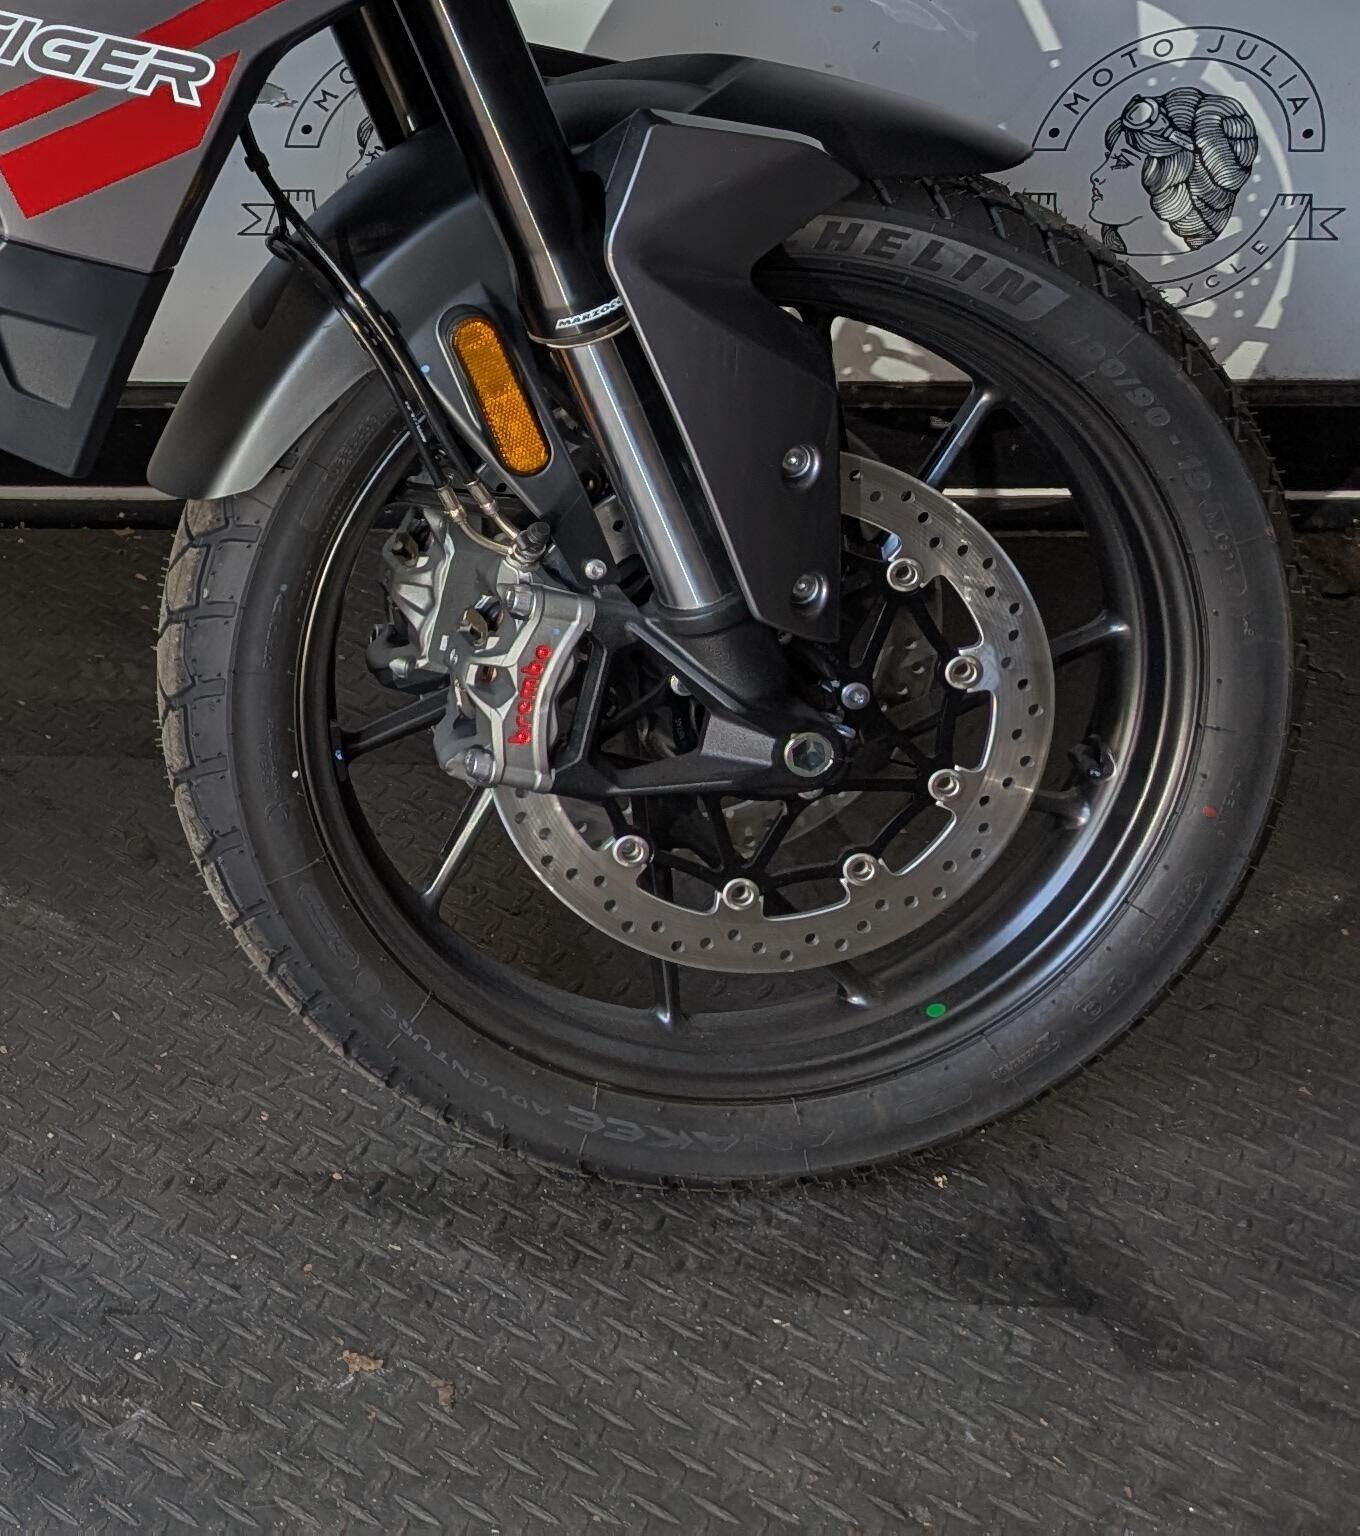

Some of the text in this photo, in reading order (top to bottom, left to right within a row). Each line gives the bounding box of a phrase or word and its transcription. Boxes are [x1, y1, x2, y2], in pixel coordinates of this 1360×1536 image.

[1063, 34, 1310, 116] MOTO JULIA
[812, 220, 1043, 306] HELIN
[507, 643, 553, 746] brembo
